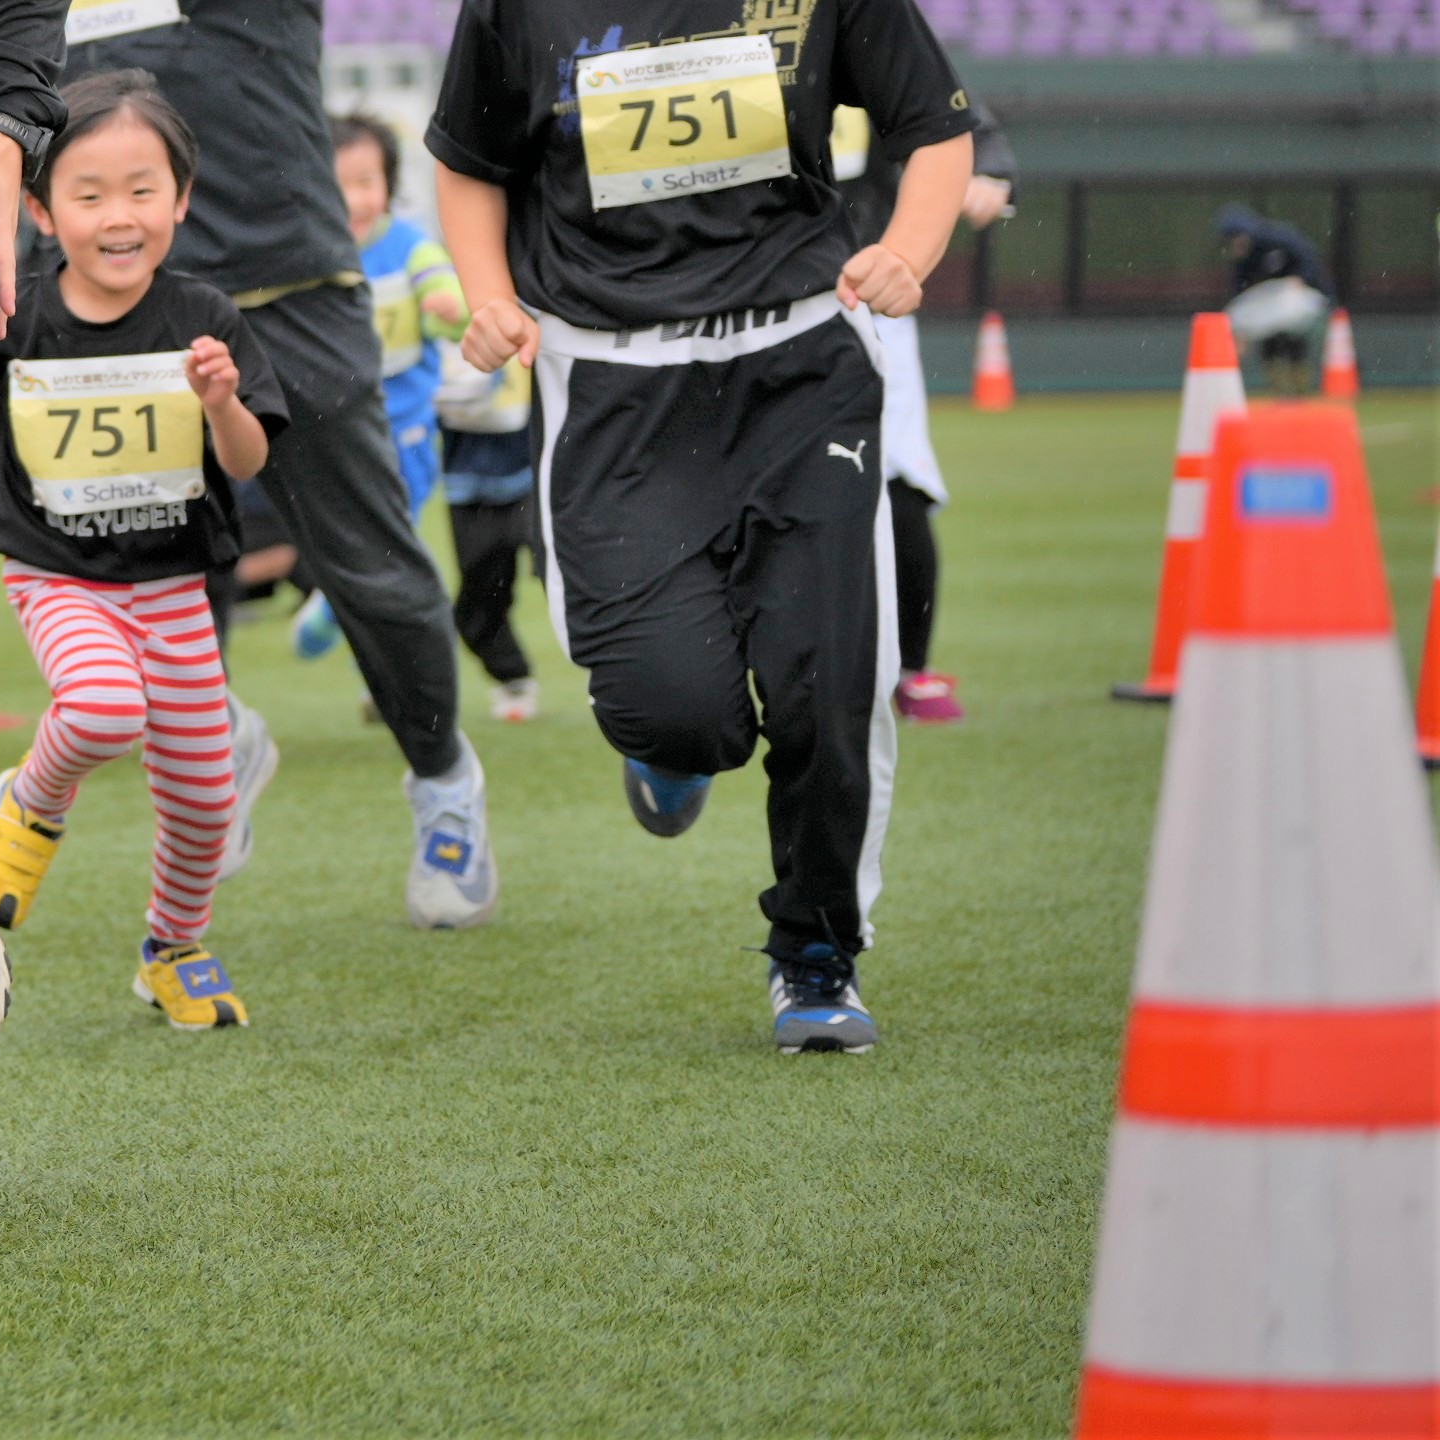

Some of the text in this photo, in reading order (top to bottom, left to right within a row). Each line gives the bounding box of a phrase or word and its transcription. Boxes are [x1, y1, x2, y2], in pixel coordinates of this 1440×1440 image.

[620, 90, 738, 152] 751
[663, 166, 743, 191] Schatz
[47, 404, 157, 460] 751
[83, 481, 158, 504] Schatz
